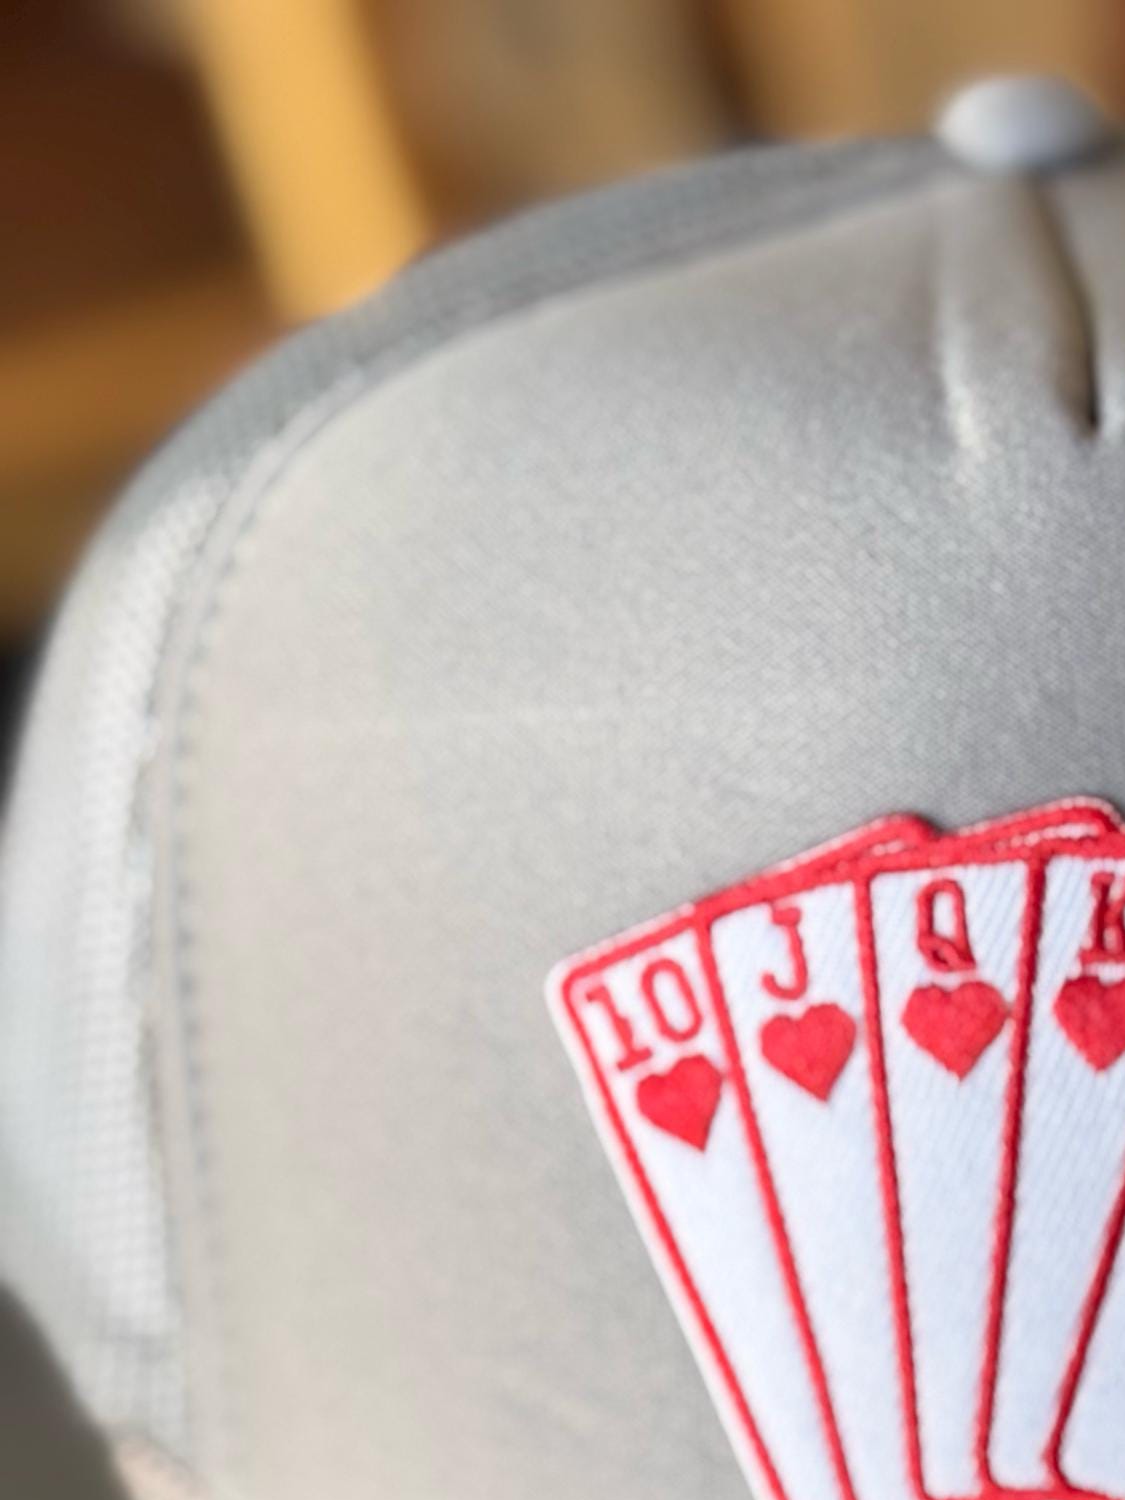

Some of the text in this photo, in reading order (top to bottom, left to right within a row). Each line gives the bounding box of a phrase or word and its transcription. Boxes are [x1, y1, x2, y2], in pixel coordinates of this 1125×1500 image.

[761, 901, 809, 1001] J
[917, 878, 975, 973] Q
[586, 958, 703, 1071] 10
